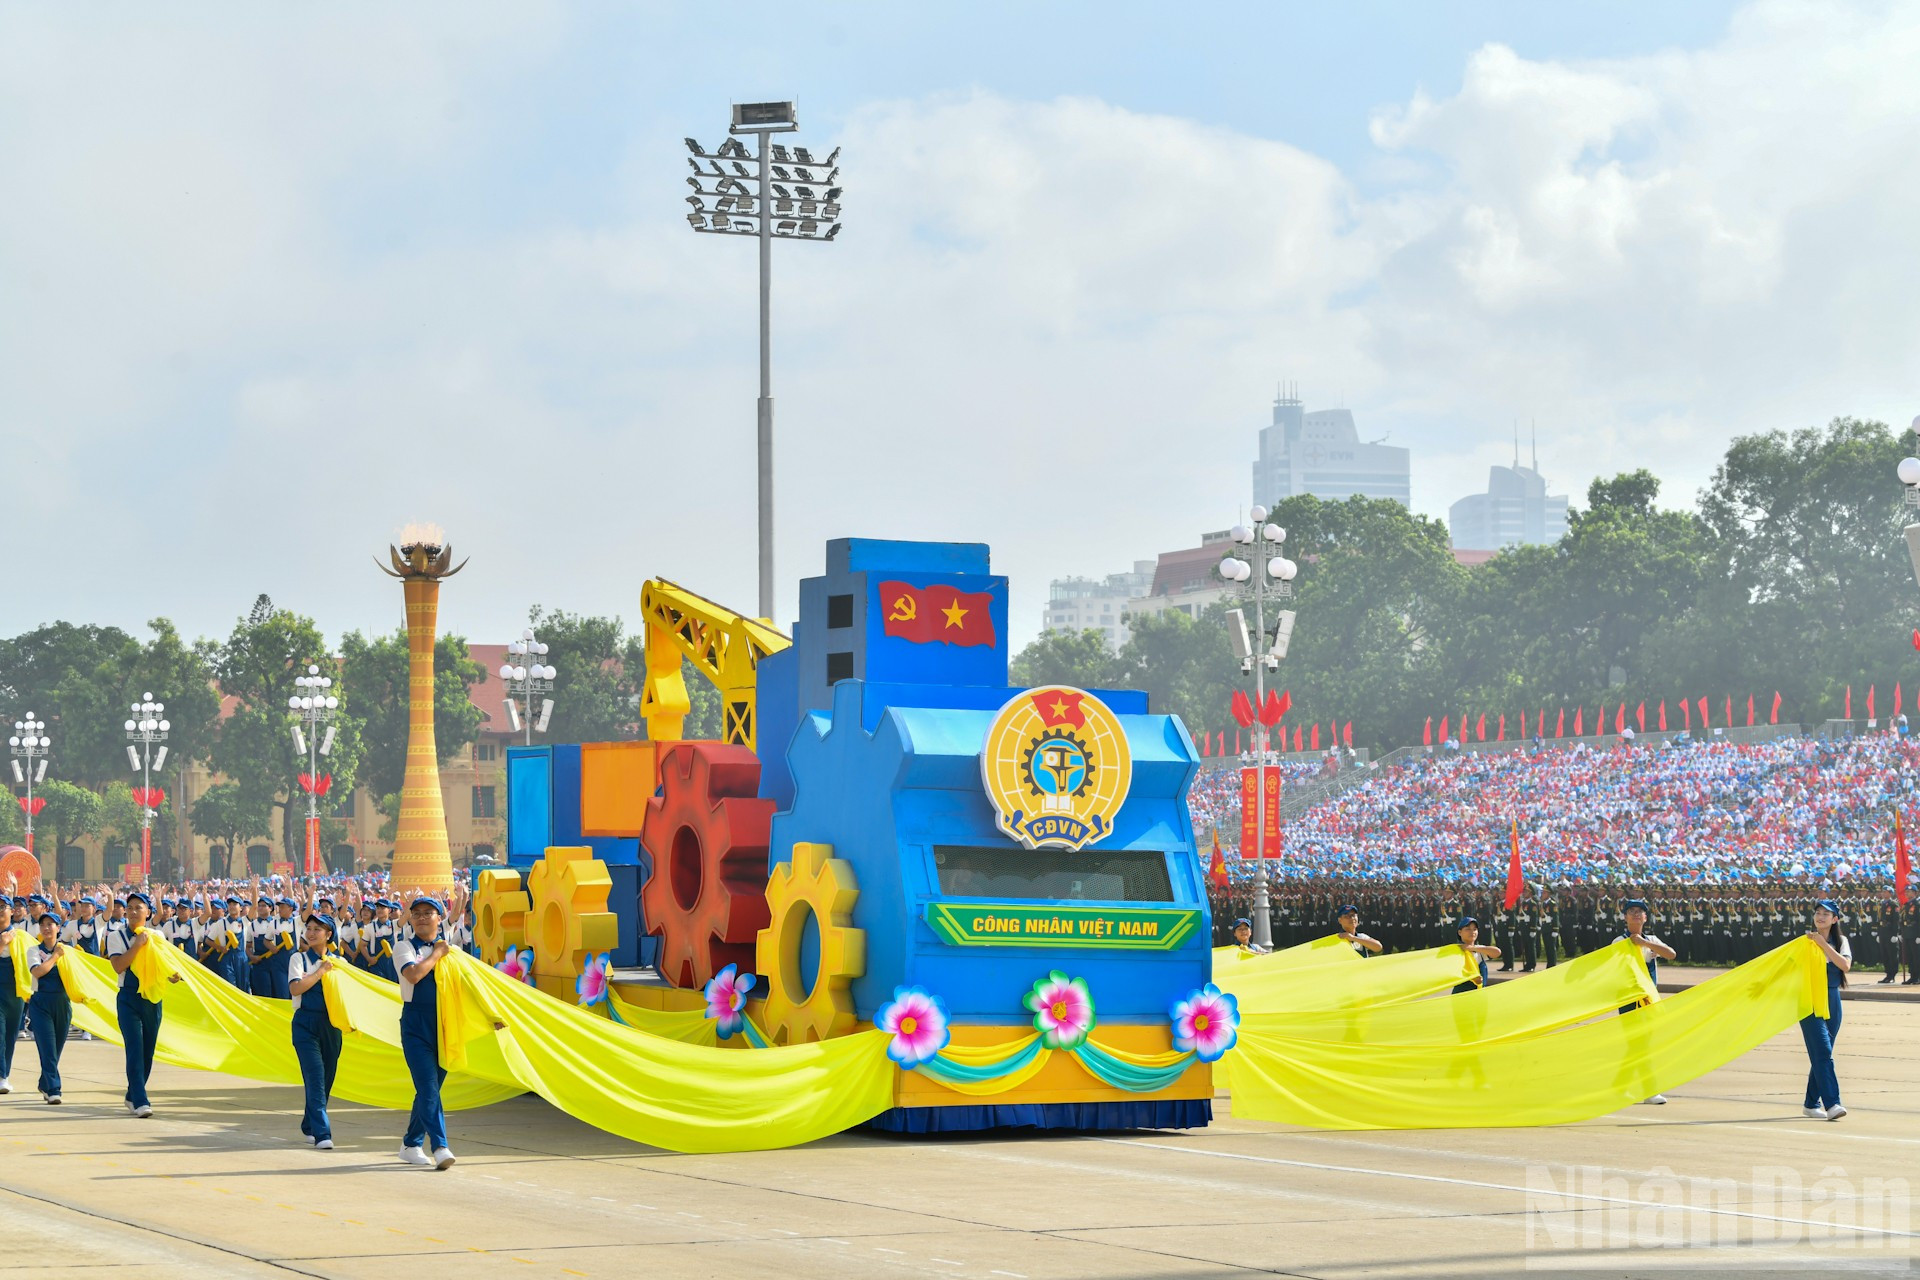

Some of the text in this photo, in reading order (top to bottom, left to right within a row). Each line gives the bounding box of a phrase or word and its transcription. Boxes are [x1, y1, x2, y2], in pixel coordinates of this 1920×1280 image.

[1329, 450, 1355, 461] EVN
[1032, 819, 1082, 839] CĐVN
[972, 915, 1158, 938] CÔNG NHÂN VIỆT NAM
